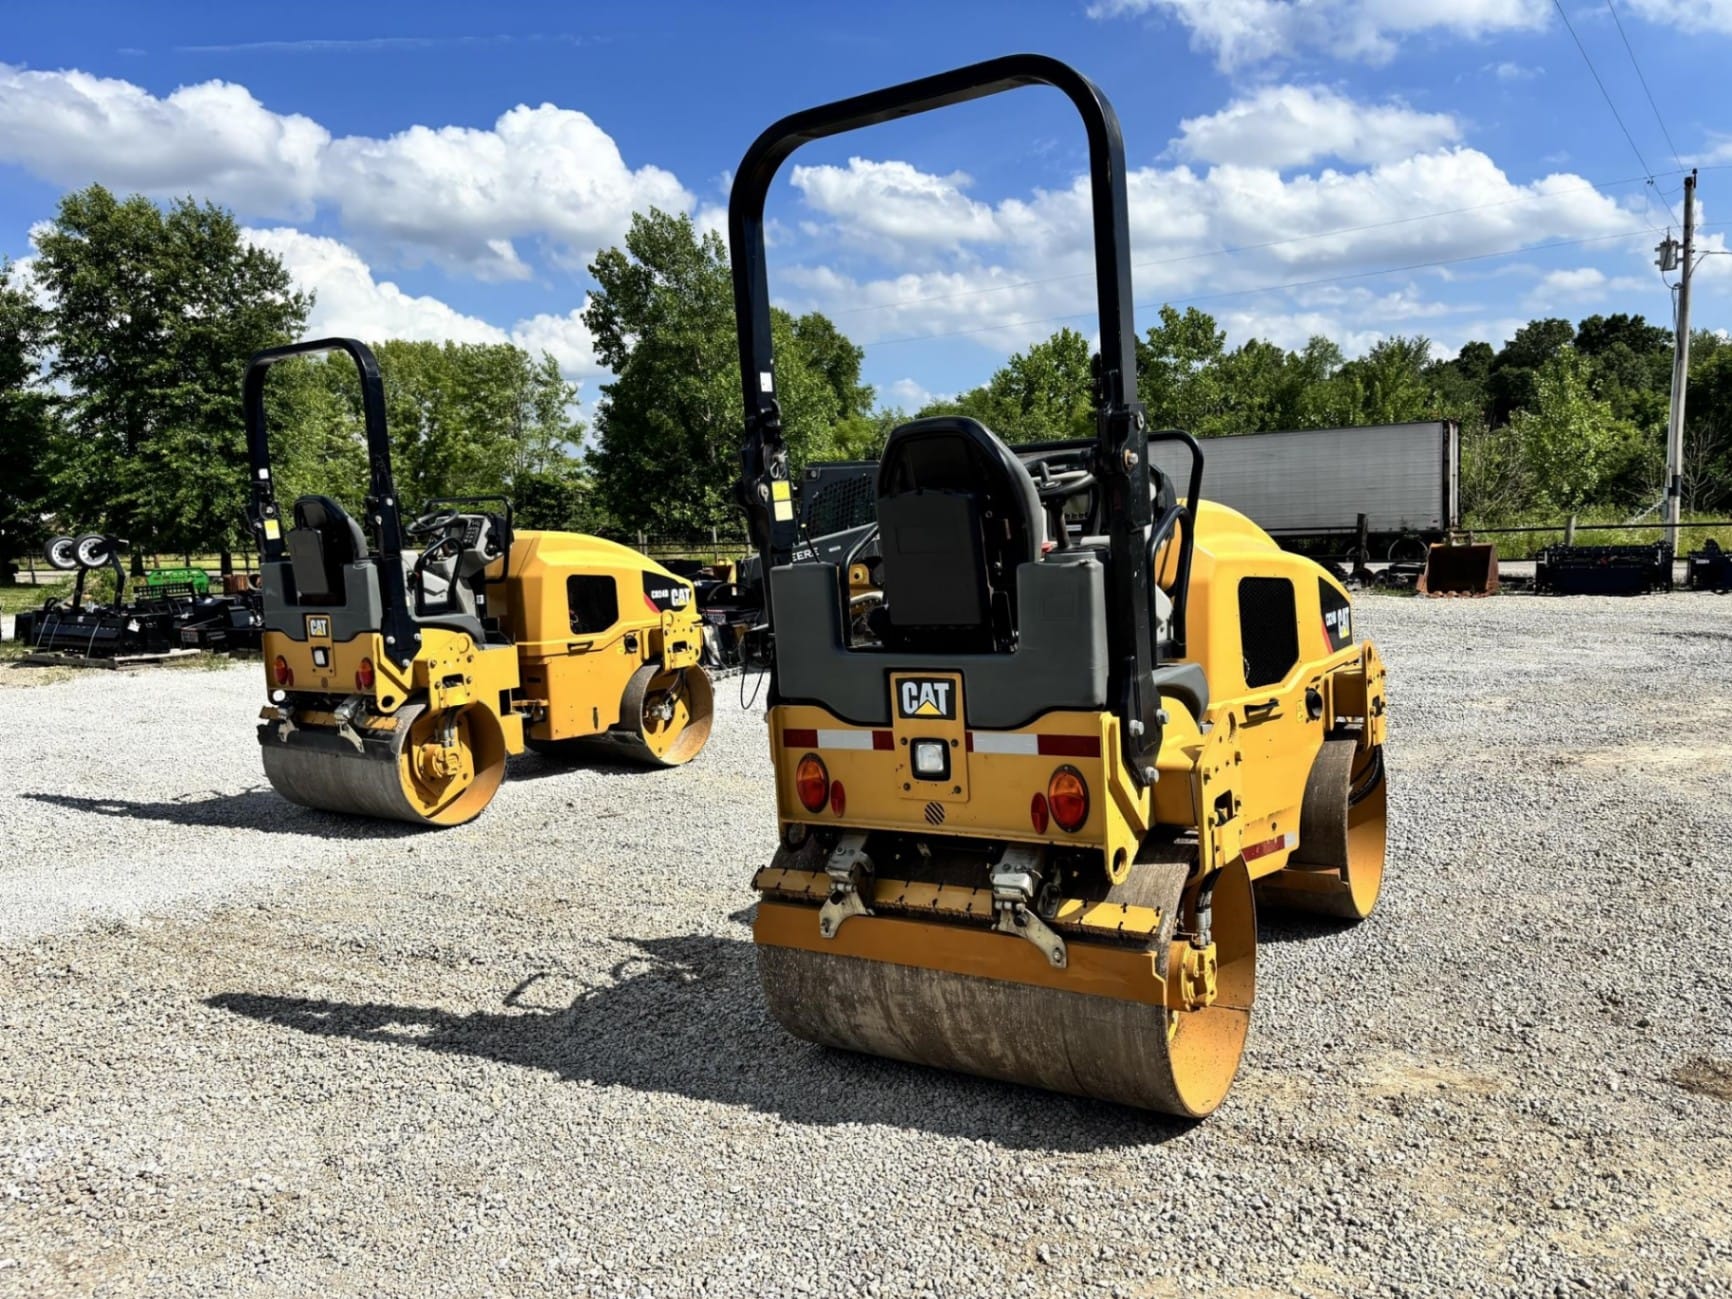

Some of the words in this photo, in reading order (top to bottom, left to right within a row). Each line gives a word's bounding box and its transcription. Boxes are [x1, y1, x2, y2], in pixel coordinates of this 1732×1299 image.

[671, 588, 690, 606] CAT
[310, 619, 327, 636] CAT
[902, 681, 950, 715] CAT
